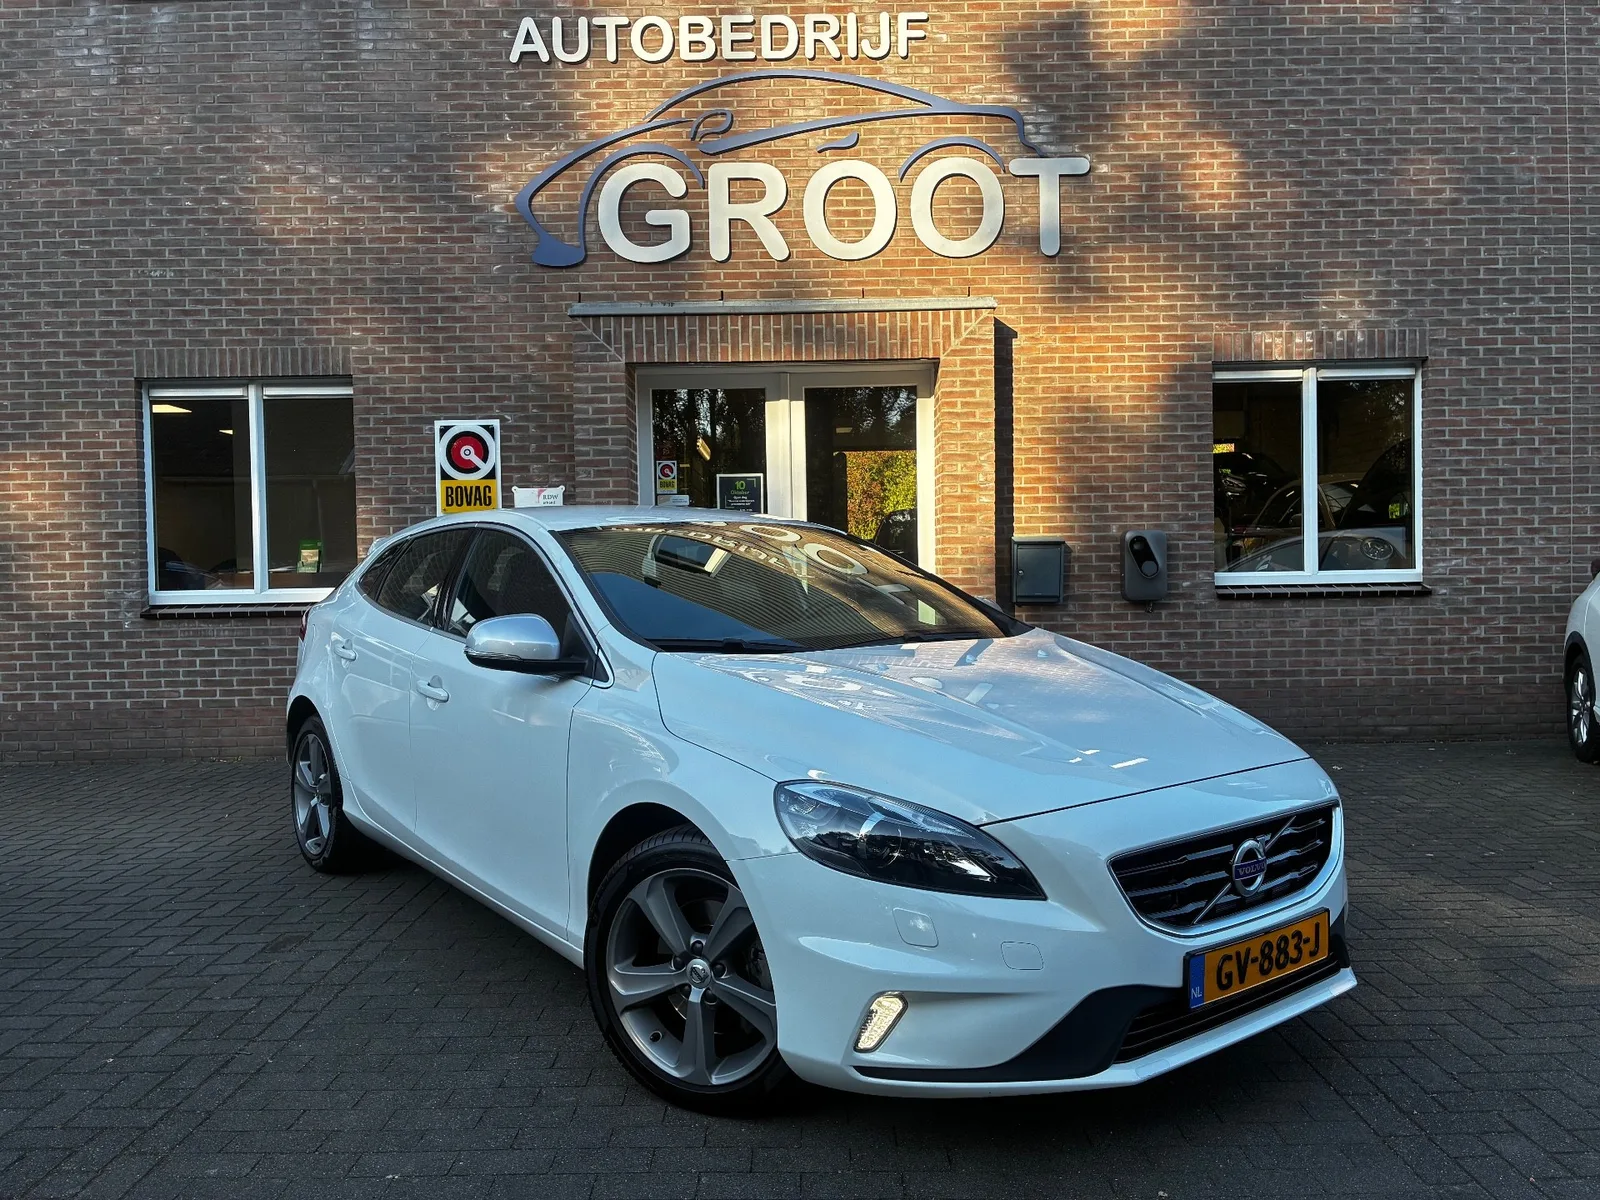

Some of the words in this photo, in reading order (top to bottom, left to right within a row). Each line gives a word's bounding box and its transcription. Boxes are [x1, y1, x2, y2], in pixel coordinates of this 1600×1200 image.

[509, 12, 929, 63] AUTOBEDRIJF
[598, 157, 1091, 263] GROOT
[445, 485, 492, 507] BOVAG
[735, 481, 745, 489] 10
[1216, 921, 1320, 991] GV-883-J
[1191, 987, 1203, 999] NL
